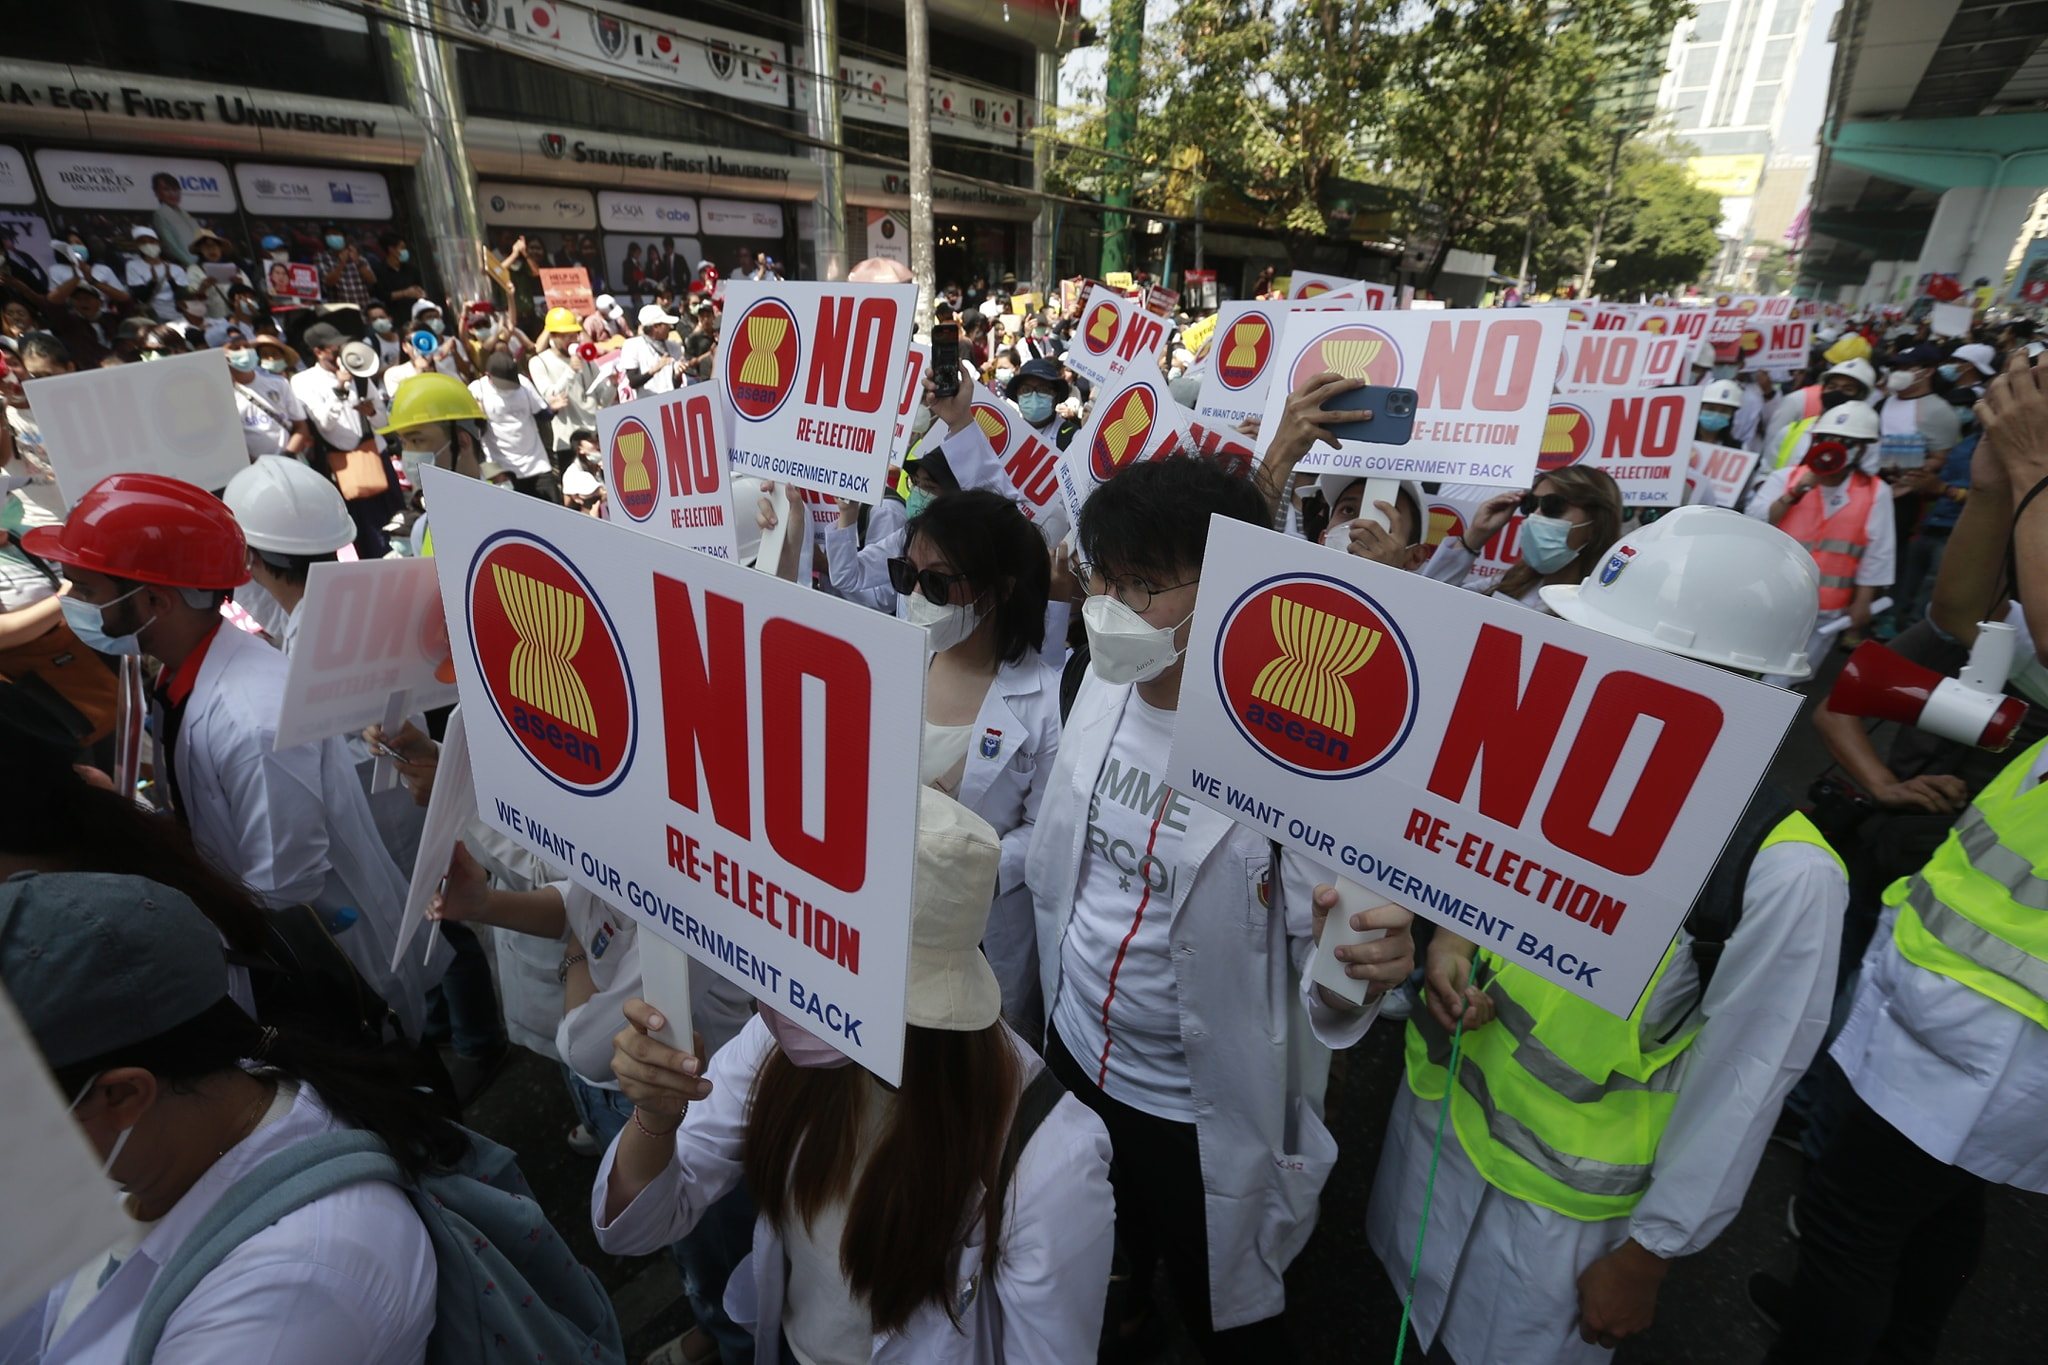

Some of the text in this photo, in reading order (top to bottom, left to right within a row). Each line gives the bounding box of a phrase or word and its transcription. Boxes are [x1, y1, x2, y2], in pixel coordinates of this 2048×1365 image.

[120, 87, 206, 121] FIRST
[215, 95, 378, 139] UNIVERSITY
[58, 171, 134, 187] BROOKES
[180, 175, 219, 193] ICM
[574, 141, 790, 181] STRATEGY FIRST UNIVERSITY
[667, 209, 690, 222] abe
[1673, 313, 1708, 340] NO
[1771, 323, 1805, 350] NO
[804, 295, 898, 414] NO
[1415, 319, 1543, 412] NO
[1572, 335, 1638, 386] NO
[736, 385, 776, 405] asean
[1202, 406, 1213, 416] WE
[1212, 408, 1231, 419] WANT
[1230, 410, 1245, 421] OUR
[659, 394, 720, 497] NO
[796, 416, 877, 455] RE-ELECTION
[1600, 395, 1686, 458] NO
[751, 452, 770, 471] OUR
[771, 457, 838, 486] GOVERNMENT
[839, 471, 871, 494] BACK
[1004, 434, 1060, 507] NO
[1059, 462, 1071, 479] WE
[1064, 477, 1077, 499] WANT
[1299, 453, 1515, 480] ANT OUR GOVERNMENT BACK
[1703, 449, 1749, 484] NO
[671, 505, 724, 529] RE-ELECTION
[1639, 491, 1669, 501] BACK
[511, 703, 602, 771] asean
[652, 570, 872, 894] NO
[1245, 701, 1352, 763] asean
[1426, 622, 1725, 877] NO
[1098, 757, 1191, 833] MME
[1191, 768, 1602, 990] WE WANT OUR GOVERNMENT BACK
[1403, 807, 1628, 936] RE-ELECTION
[494, 796, 864, 1049] WE WANT OUR GOVERNMENT BACK
[666, 823, 860, 976] RE-ELECTION
